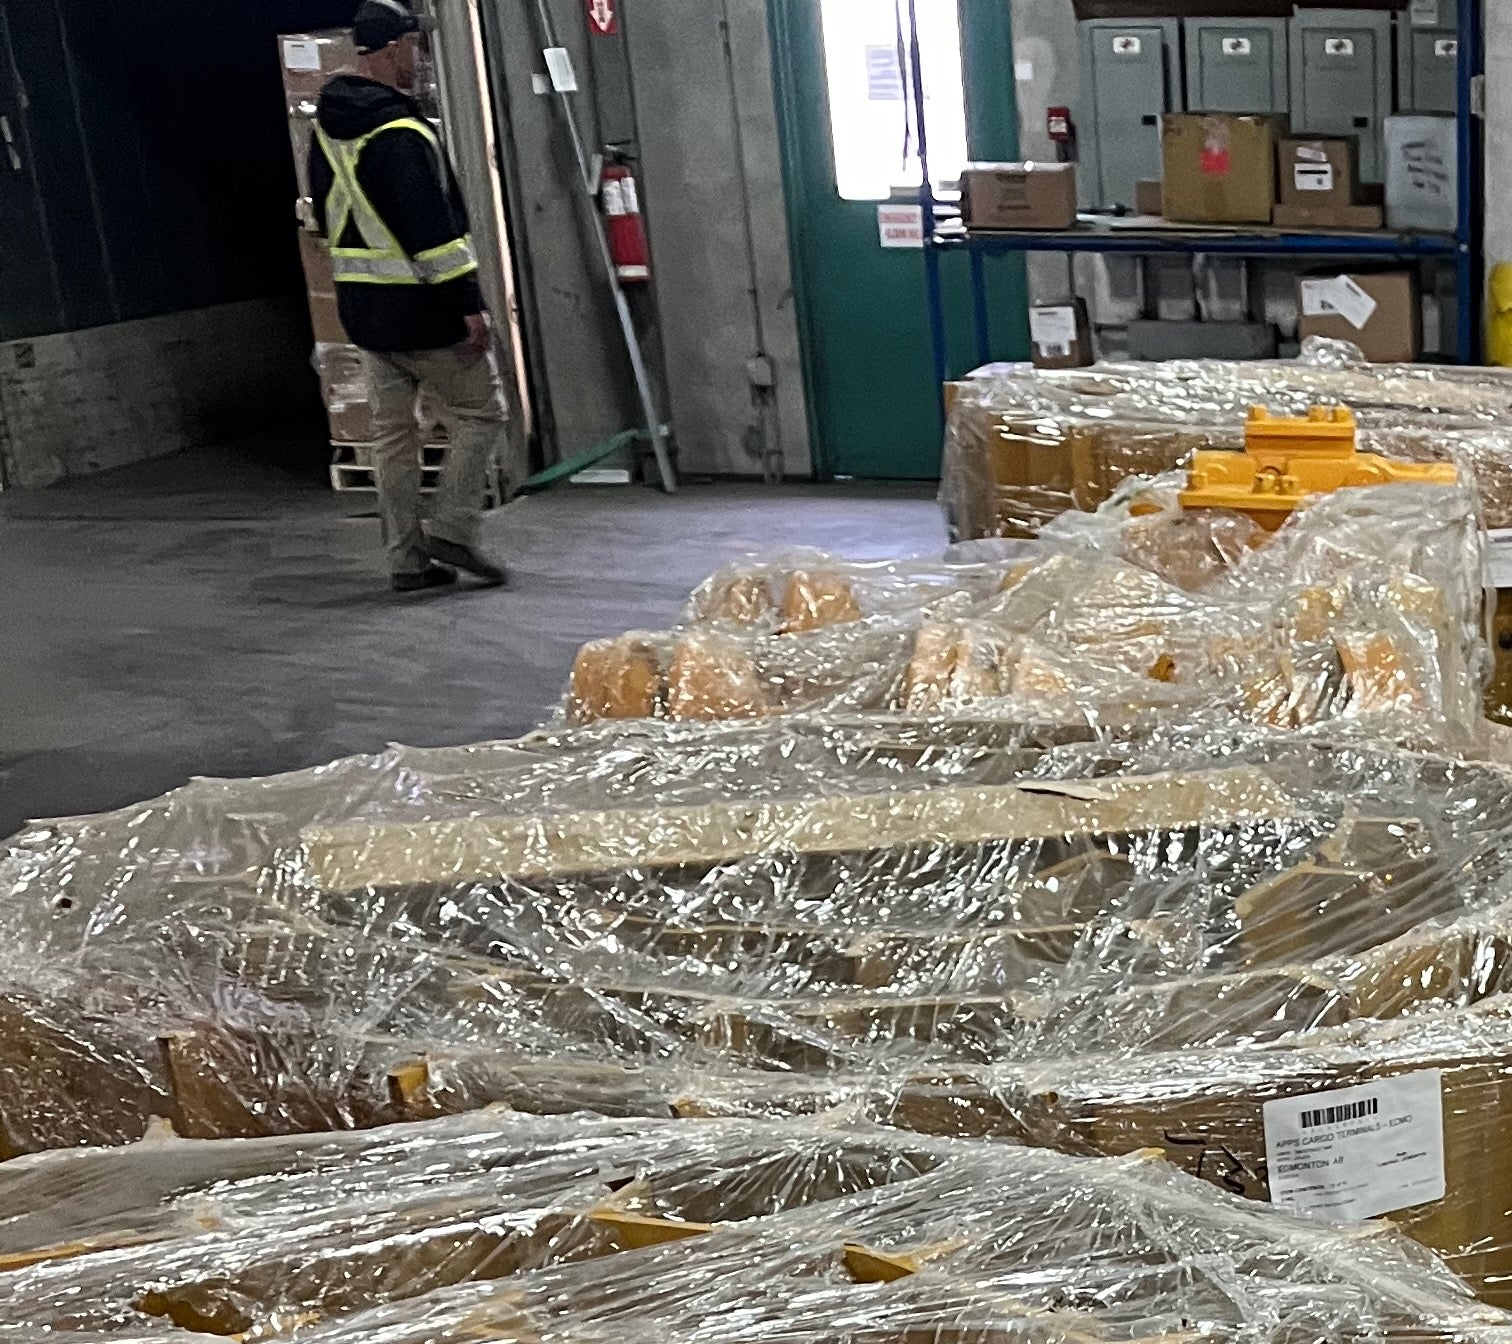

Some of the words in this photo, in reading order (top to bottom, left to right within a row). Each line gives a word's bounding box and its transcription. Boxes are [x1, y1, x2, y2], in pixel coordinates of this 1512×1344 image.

[1275, 1138, 1299, 1148] APPS
[1302, 1133, 1334, 1145] CARGO
[1337, 1122, 1381, 1139] TERMINALS
[1389, 1115, 1412, 1127] EDMO
[1277, 1160, 1329, 1173] EDMONTON
[1332, 1156, 1344, 1165] AB
